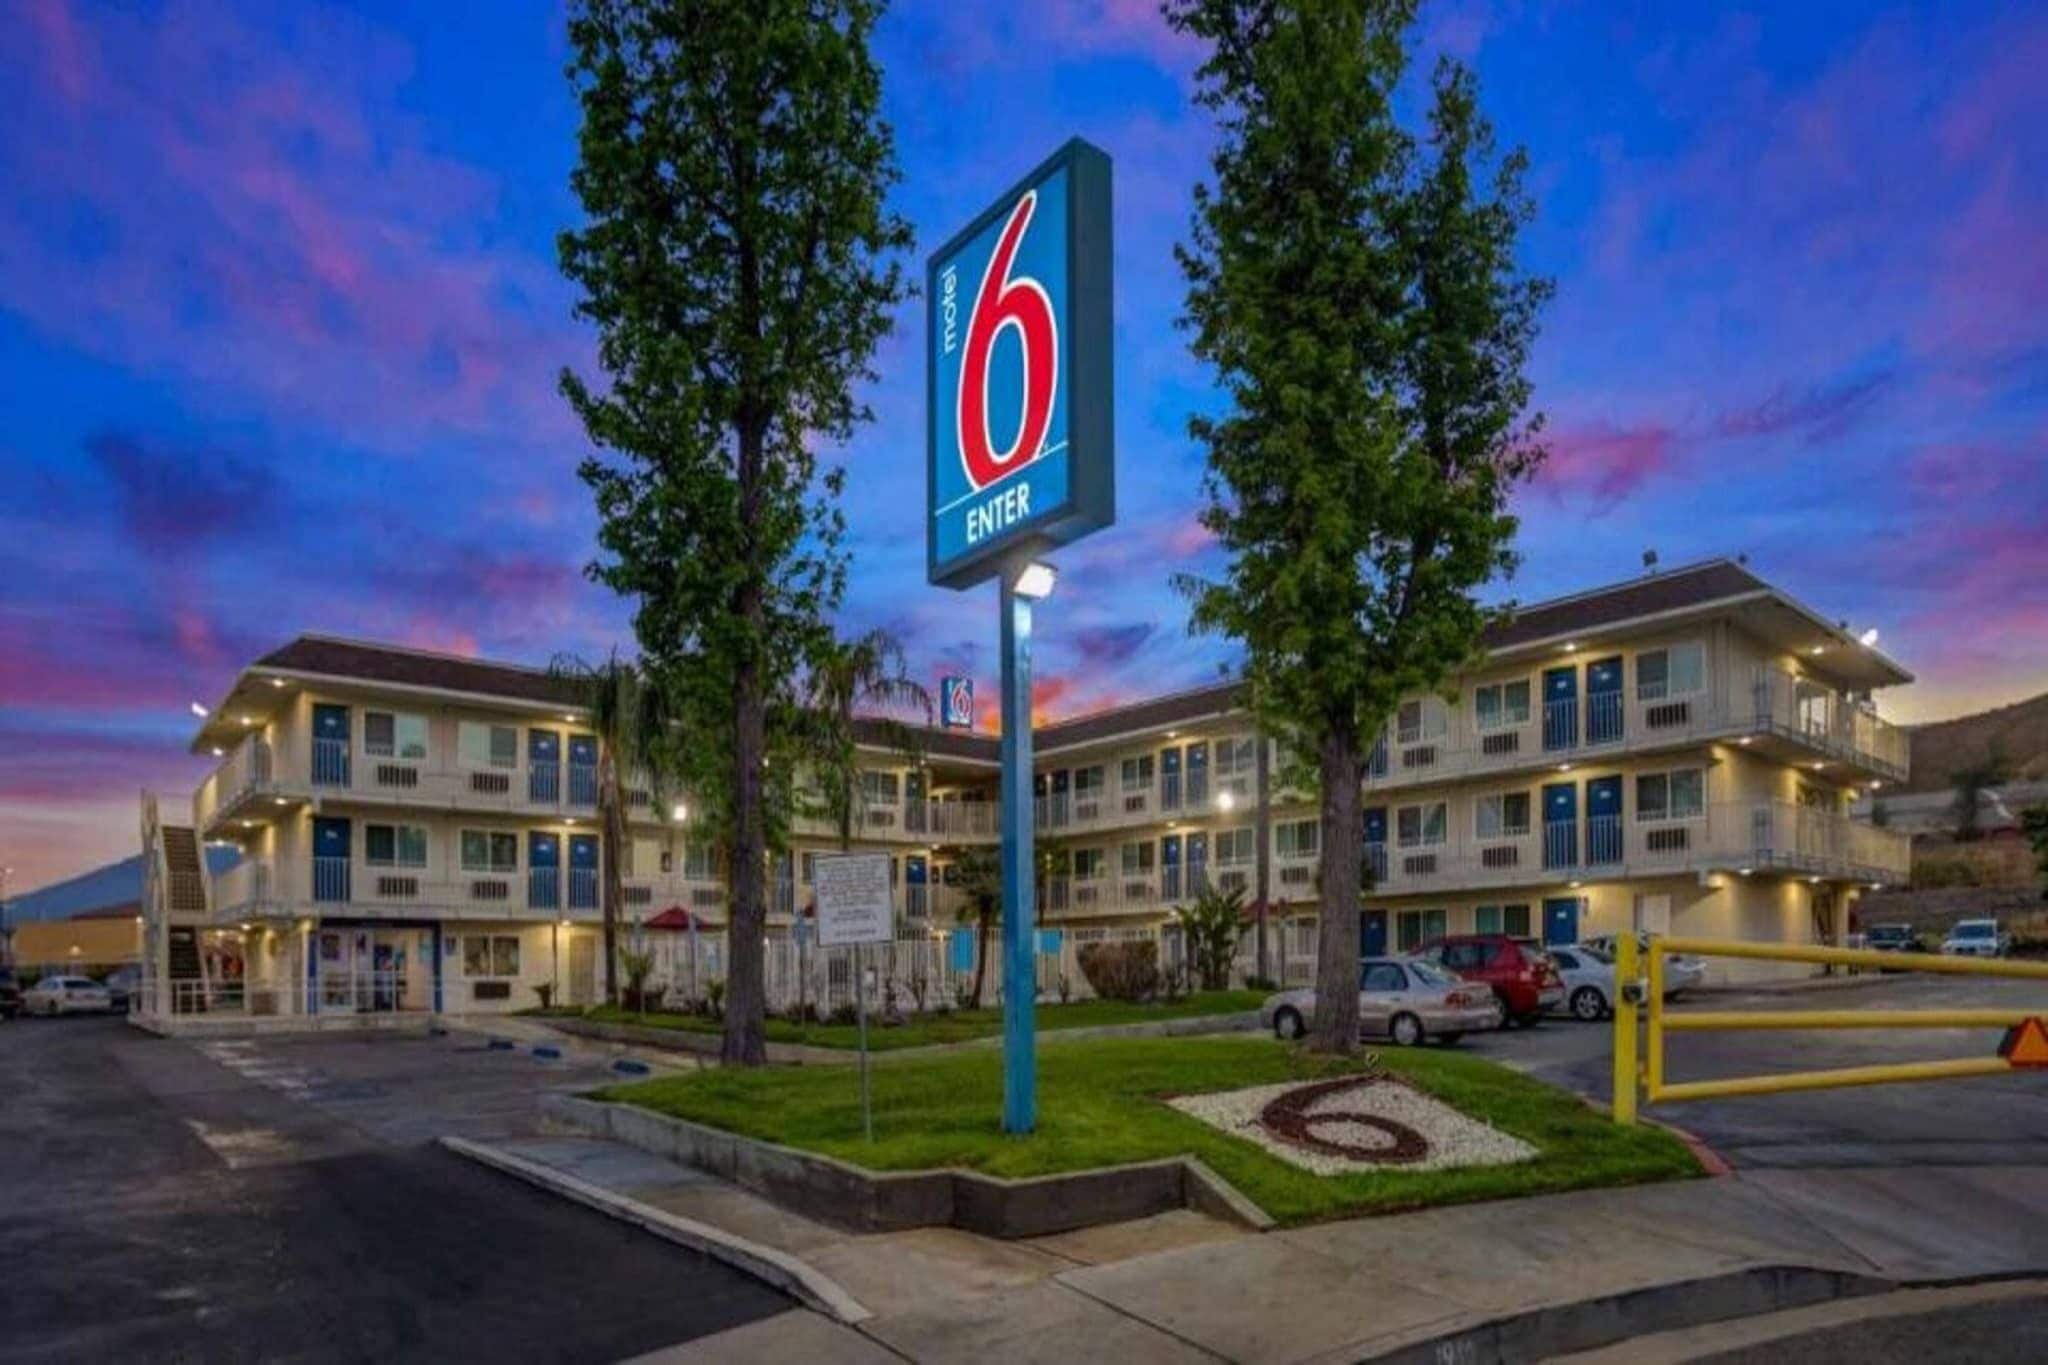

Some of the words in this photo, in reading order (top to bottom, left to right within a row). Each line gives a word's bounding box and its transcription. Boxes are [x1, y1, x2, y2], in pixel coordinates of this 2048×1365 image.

[941, 265, 957, 353] motel
[957, 189, 1058, 492] 6
[966, 481, 1031, 543] ENTER
[1261, 1073, 1430, 1164] 6
